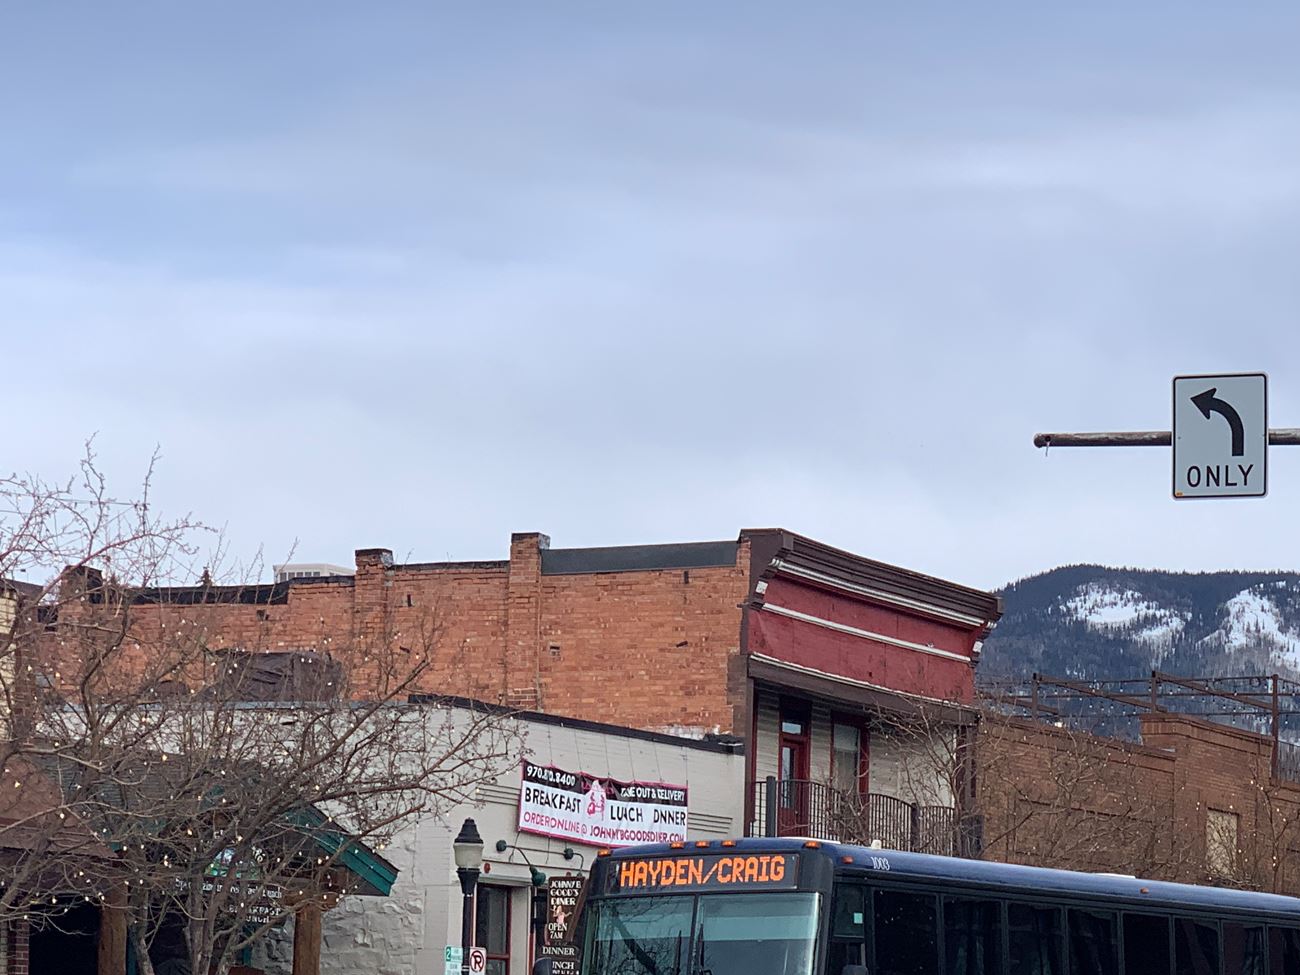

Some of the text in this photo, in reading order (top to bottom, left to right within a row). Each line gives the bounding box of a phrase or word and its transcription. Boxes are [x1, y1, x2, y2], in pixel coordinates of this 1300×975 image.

[1186, 464, 1255, 488] ONLY
[524, 786, 582, 815] BREAKFAST
[653, 808, 687, 826] DNNER
[870, 856, 890, 871] 1003
[620, 855, 785, 887] HAYDEN/CRAIG
[550, 897, 576, 906] DINER
[548, 922, 568, 932] OPEN
[446, 947, 452, 961] 2
[542, 946, 575, 956] DINNER
[552, 961, 575, 970] NCH
